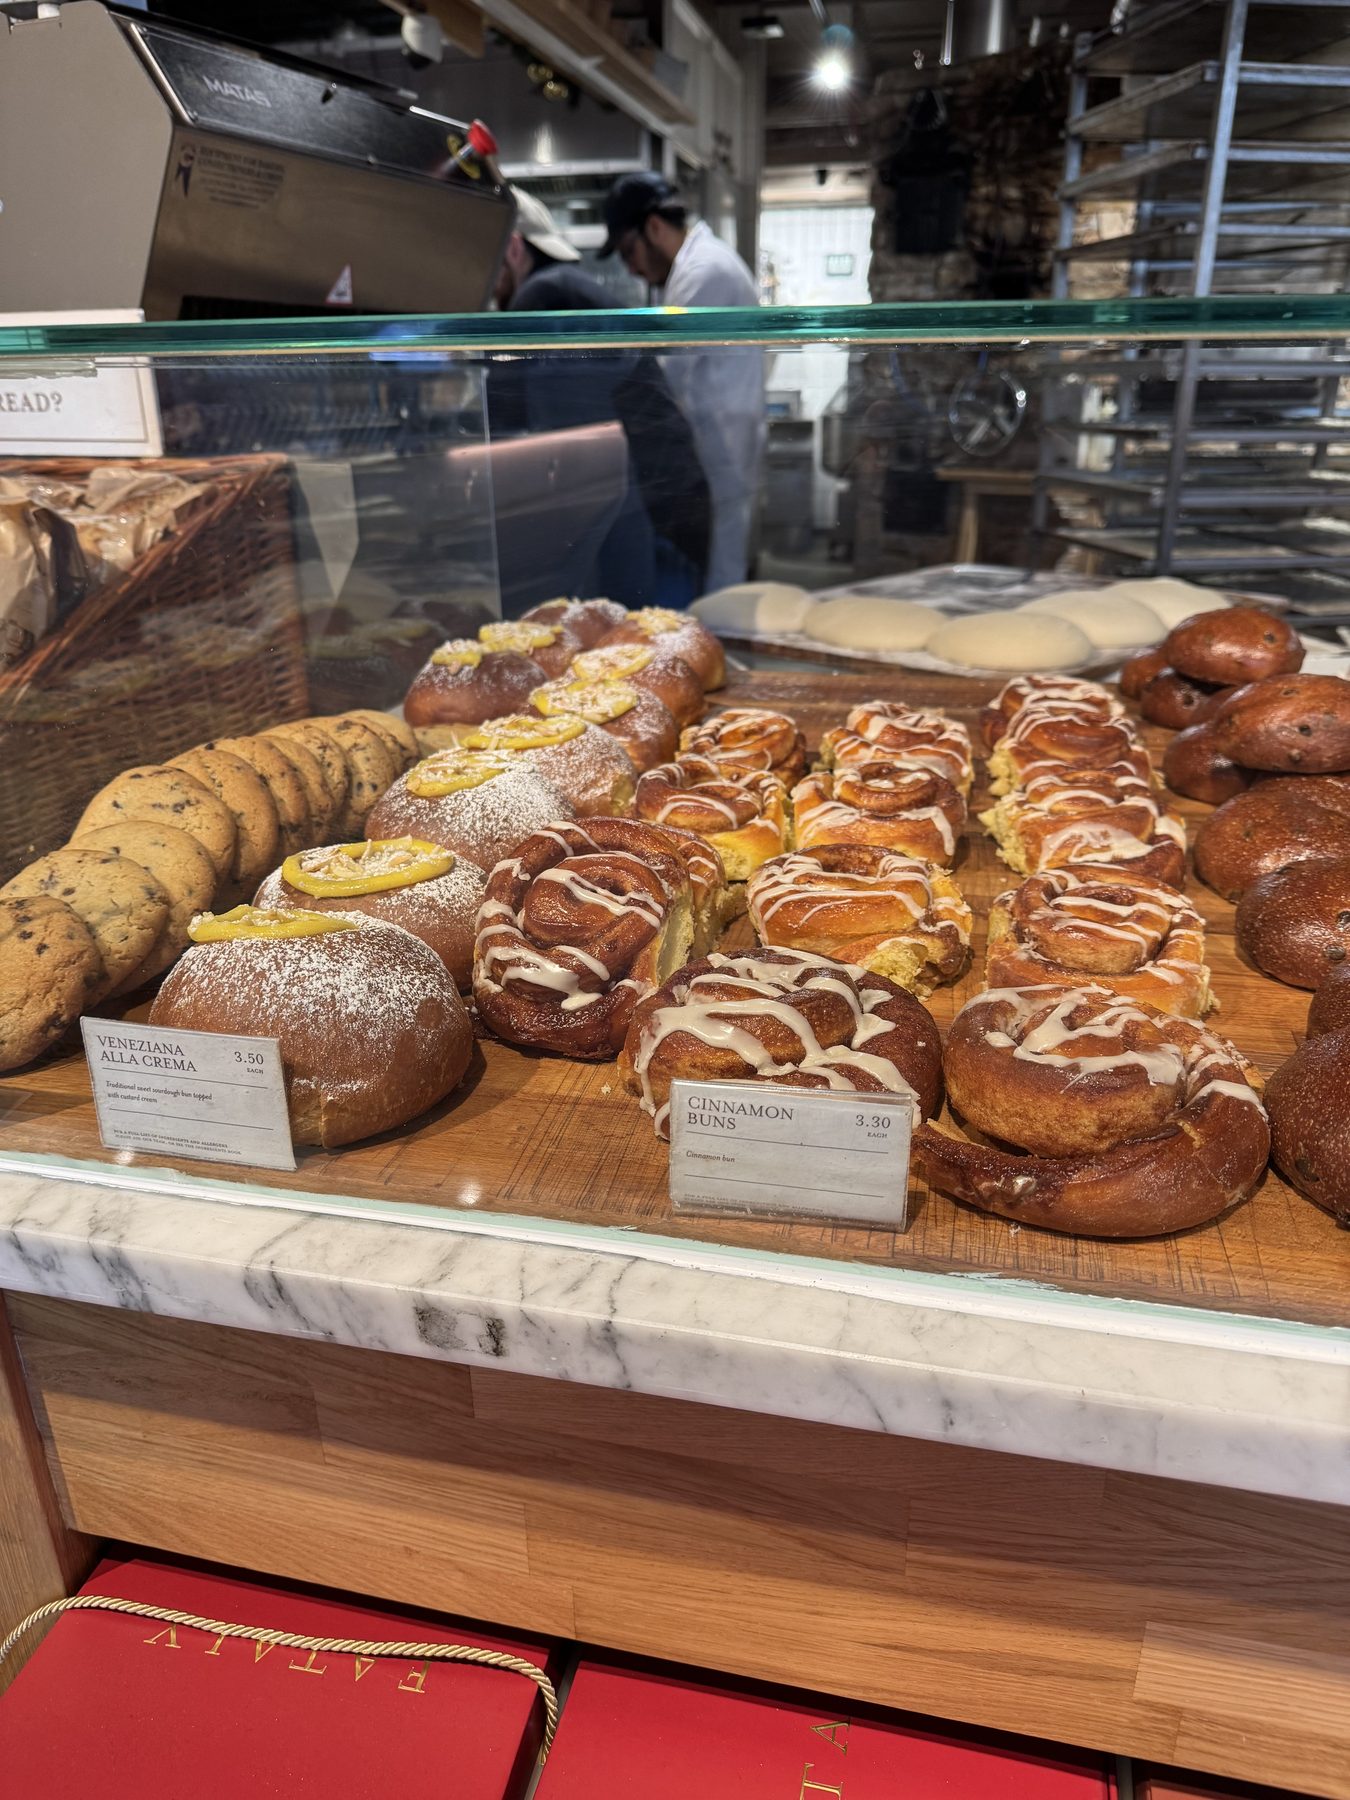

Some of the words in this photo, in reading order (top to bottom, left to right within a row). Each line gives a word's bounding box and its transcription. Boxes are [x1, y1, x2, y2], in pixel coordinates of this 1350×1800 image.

[96, 1035, 185, 1056] VENEZIANA
[100, 1050, 140, 1066] ALLA
[142, 1055, 198, 1073] CREMA
[234, 1051, 264, 1065] 3.50
[246, 1067, 264, 1075] EACH
[106, 1080, 136, 1091] Traditional
[137, 1085, 152, 1093] sweet
[152, 1087, 180, 1098] sourdough
[181, 1090, 192, 1098] bun
[193, 1092, 212, 1101] topped
[120, 1093, 141, 1101] custard
[688, 1096, 794, 1121] CINNAMON
[687, 1112, 737, 1130] BUNS
[855, 1114, 891, 1129] 3.30
[867, 1131, 888, 1139] EACH
[686, 1150, 721, 1161] Cinnamon
[722, 1154, 736, 1163] bun
